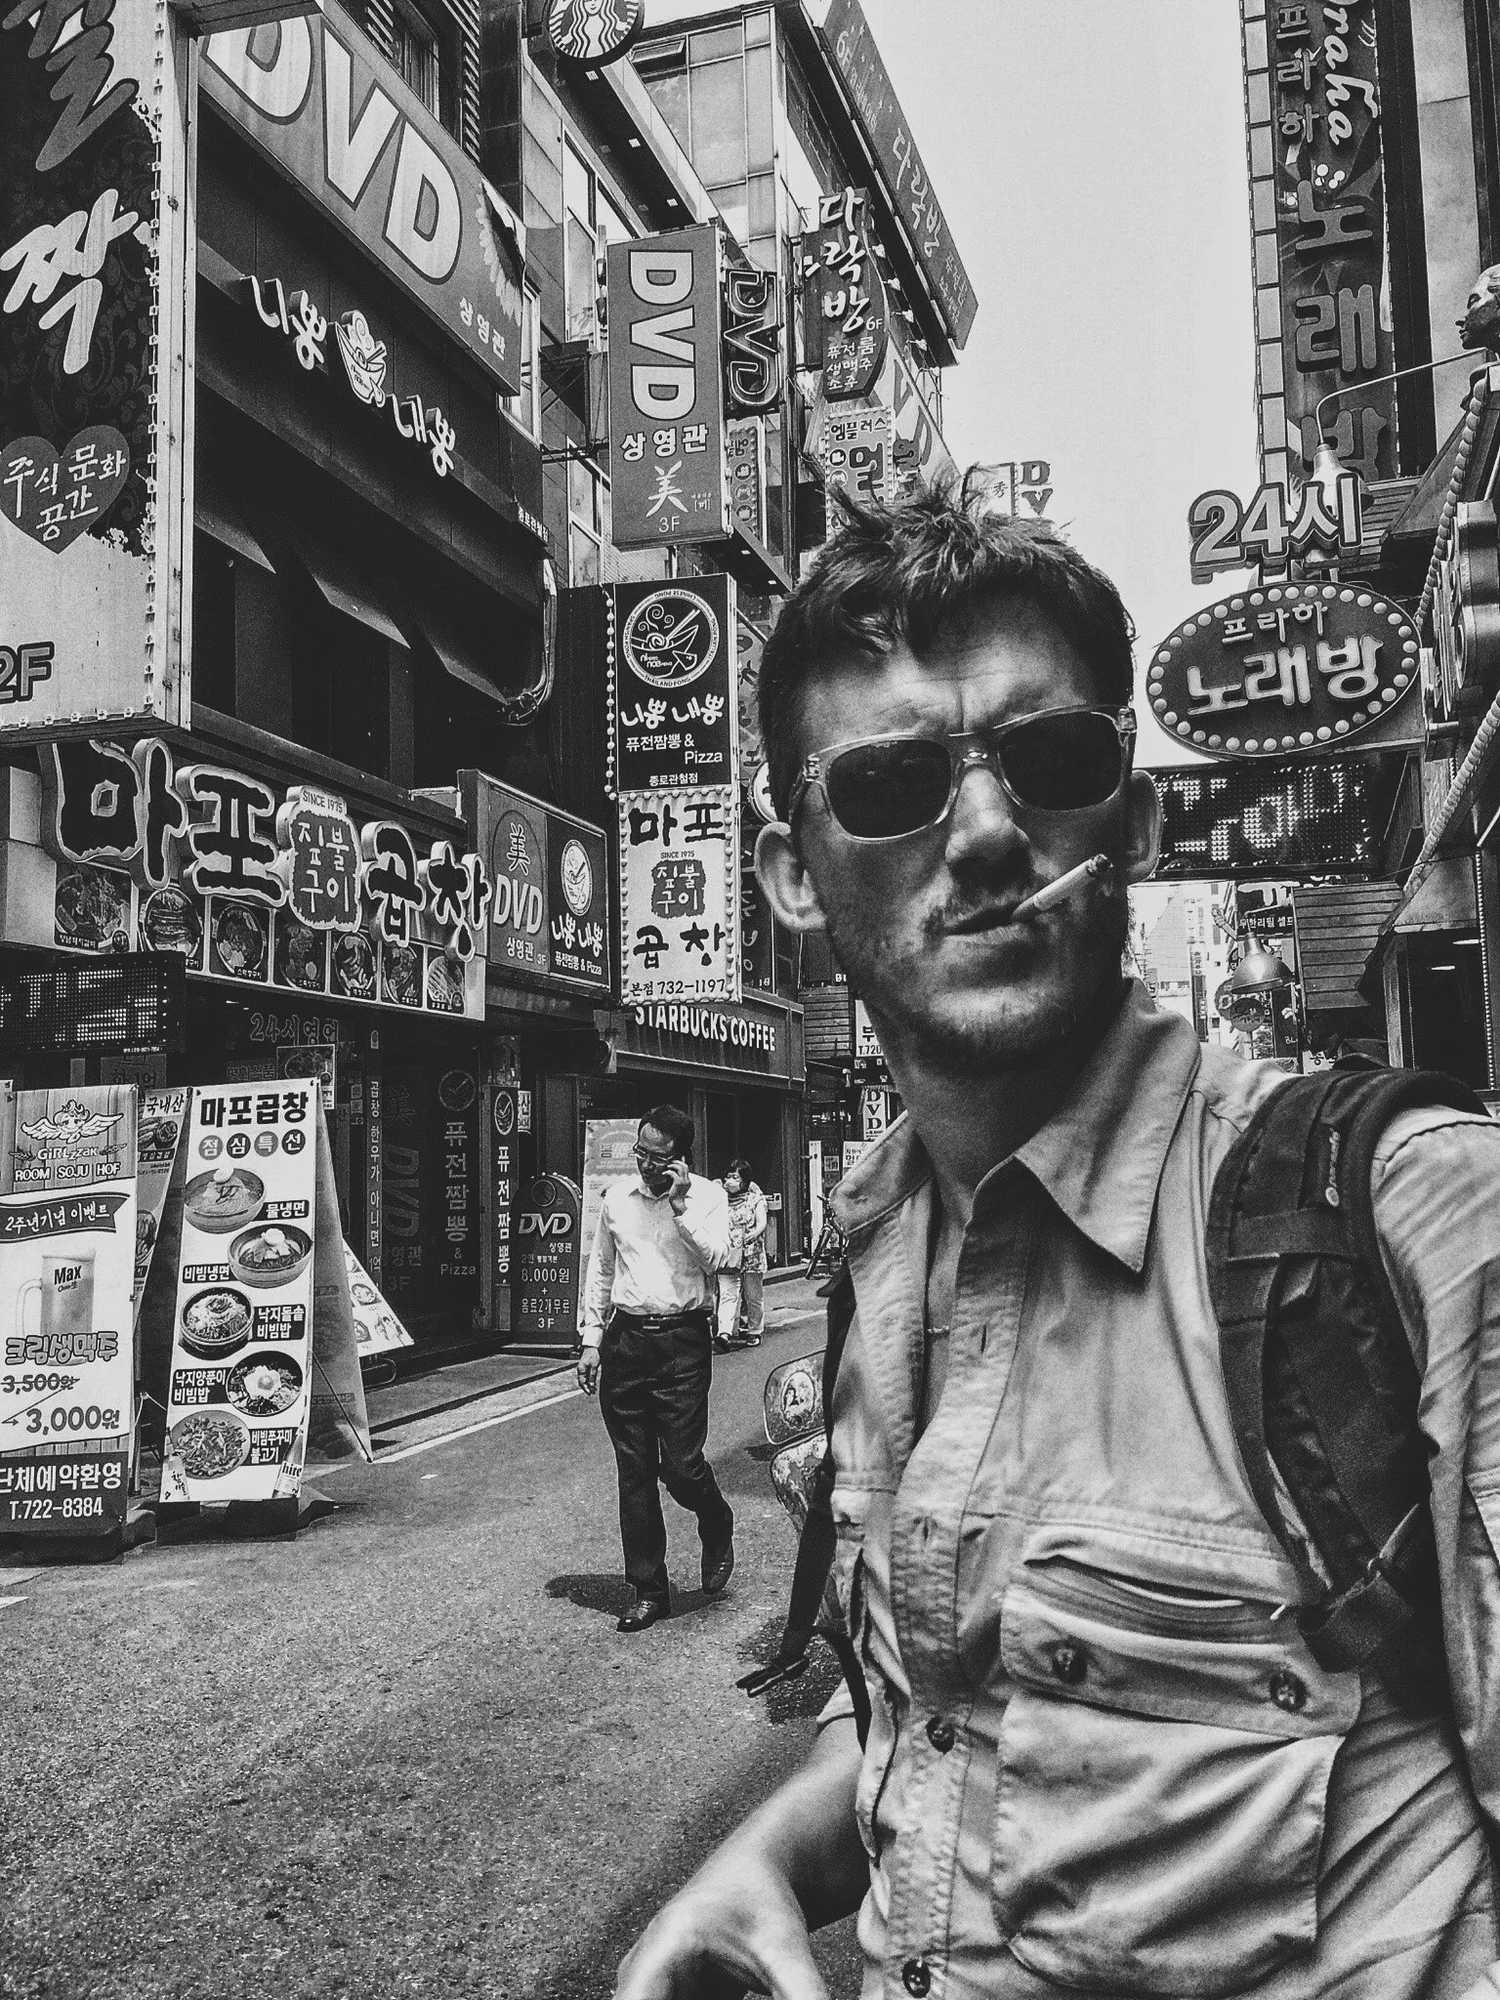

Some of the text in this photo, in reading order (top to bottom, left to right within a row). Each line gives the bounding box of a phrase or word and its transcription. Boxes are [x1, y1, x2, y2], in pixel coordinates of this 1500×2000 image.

[1276, 5, 1320, 142] 프라하
[1323, 0, 1378, 145] raha
[202, 15, 462, 285] DVD
[820, 187, 869, 333] 다락방
[460, 297, 506, 361] 상영관
[629, 250, 696, 421] DVD
[866, 317, 884, 331] 6F
[827, 336, 877, 360] 퓨전룸
[827, 358, 873, 377] 생맥주
[828, 375, 859, 391] 소주
[620, 423, 709, 462] 상영관
[830, 417, 887, 441] 엠플러스
[4, 444, 127, 519] 주식 문화
[646, 460, 689, 518] 美
[1020, 460, 1053, 530] DV
[36, 485, 99, 542] 공간
[658, 516, 681, 533] 3F
[1189, 473, 1362, 566] 24시
[1222, 601, 1329, 643] 프라하
[1187, 633, 1384, 715] 노래방
[671, 693, 725, 726] 내뽕
[625, 733, 695, 752] 퓨전짬뽕 &
[684, 750, 723, 764] Pizza
[649, 772, 699, 787] 종로관철점
[303, 790, 343, 814] SINCE 1975
[52, 737, 290, 906] 마포
[628, 803, 727, 847] 마포
[506, 822, 531, 876] 美
[660, 850, 695, 859] SINCE 1975
[300, 869, 350, 914] 구이
[365, 820, 492, 963] 곱창
[493, 873, 543, 935] DVD
[656, 889, 699, 915] 구이
[506, 937, 547, 965] 상영관 3F
[633, 922, 727, 969] 곱창
[586, 960, 602, 975] Pizza
[630, 981, 654, 997] 본점
[657, 979, 726, 995] 732-1197
[635, 1004, 776, 1051] STARBUCKS COFFEE
[200, 1091, 309, 1128] 마포곱창
[370, 1081, 380, 1118] 곱창
[867, 1090, 882, 1130] DVD
[202, 1132, 304, 1158] 점심특선
[370, 1125, 380, 1182] 한우가
[15, 1166, 51, 1182] ROOM
[56, 1163, 89, 1180] SOJU
[95, 1161, 122, 1176] HOF
[444, 1121, 469, 1242] 퓨전짬뽕
[5, 1200, 110, 1235] 2주년기념 이벤트
[266, 1200, 306, 1219] 물냉면
[370, 1190, 380, 1248] 아니면
[497, 1146, 511, 1274] 퓨전짬뽕
[518, 1213, 572, 1238] DVD
[454, 1246, 463, 1259] &
[549, 1242, 572, 1253] 상영관
[54, 1265, 82, 1285] Max
[184, 1266, 231, 1282] 비빔냉면
[440, 1262, 476, 1276] Pizza
[521, 1267, 570, 1284] 8.000원
[257, 1323, 292, 1340] 비빔밥
[538, 1317, 555, 1329] 3F
[5, 1331, 118, 1366] 크림생맥주
[2, 1373, 75, 1394] 3,500원
[175, 1369, 226, 1387] 낙지양푼이
[174, 1387, 211, 1404] 비빔밥
[26, 1405, 120, 1435] 3,000원
[250, 1448, 279, 1464] 불고기
[10, 1497, 104, 1520] T.722-8384
